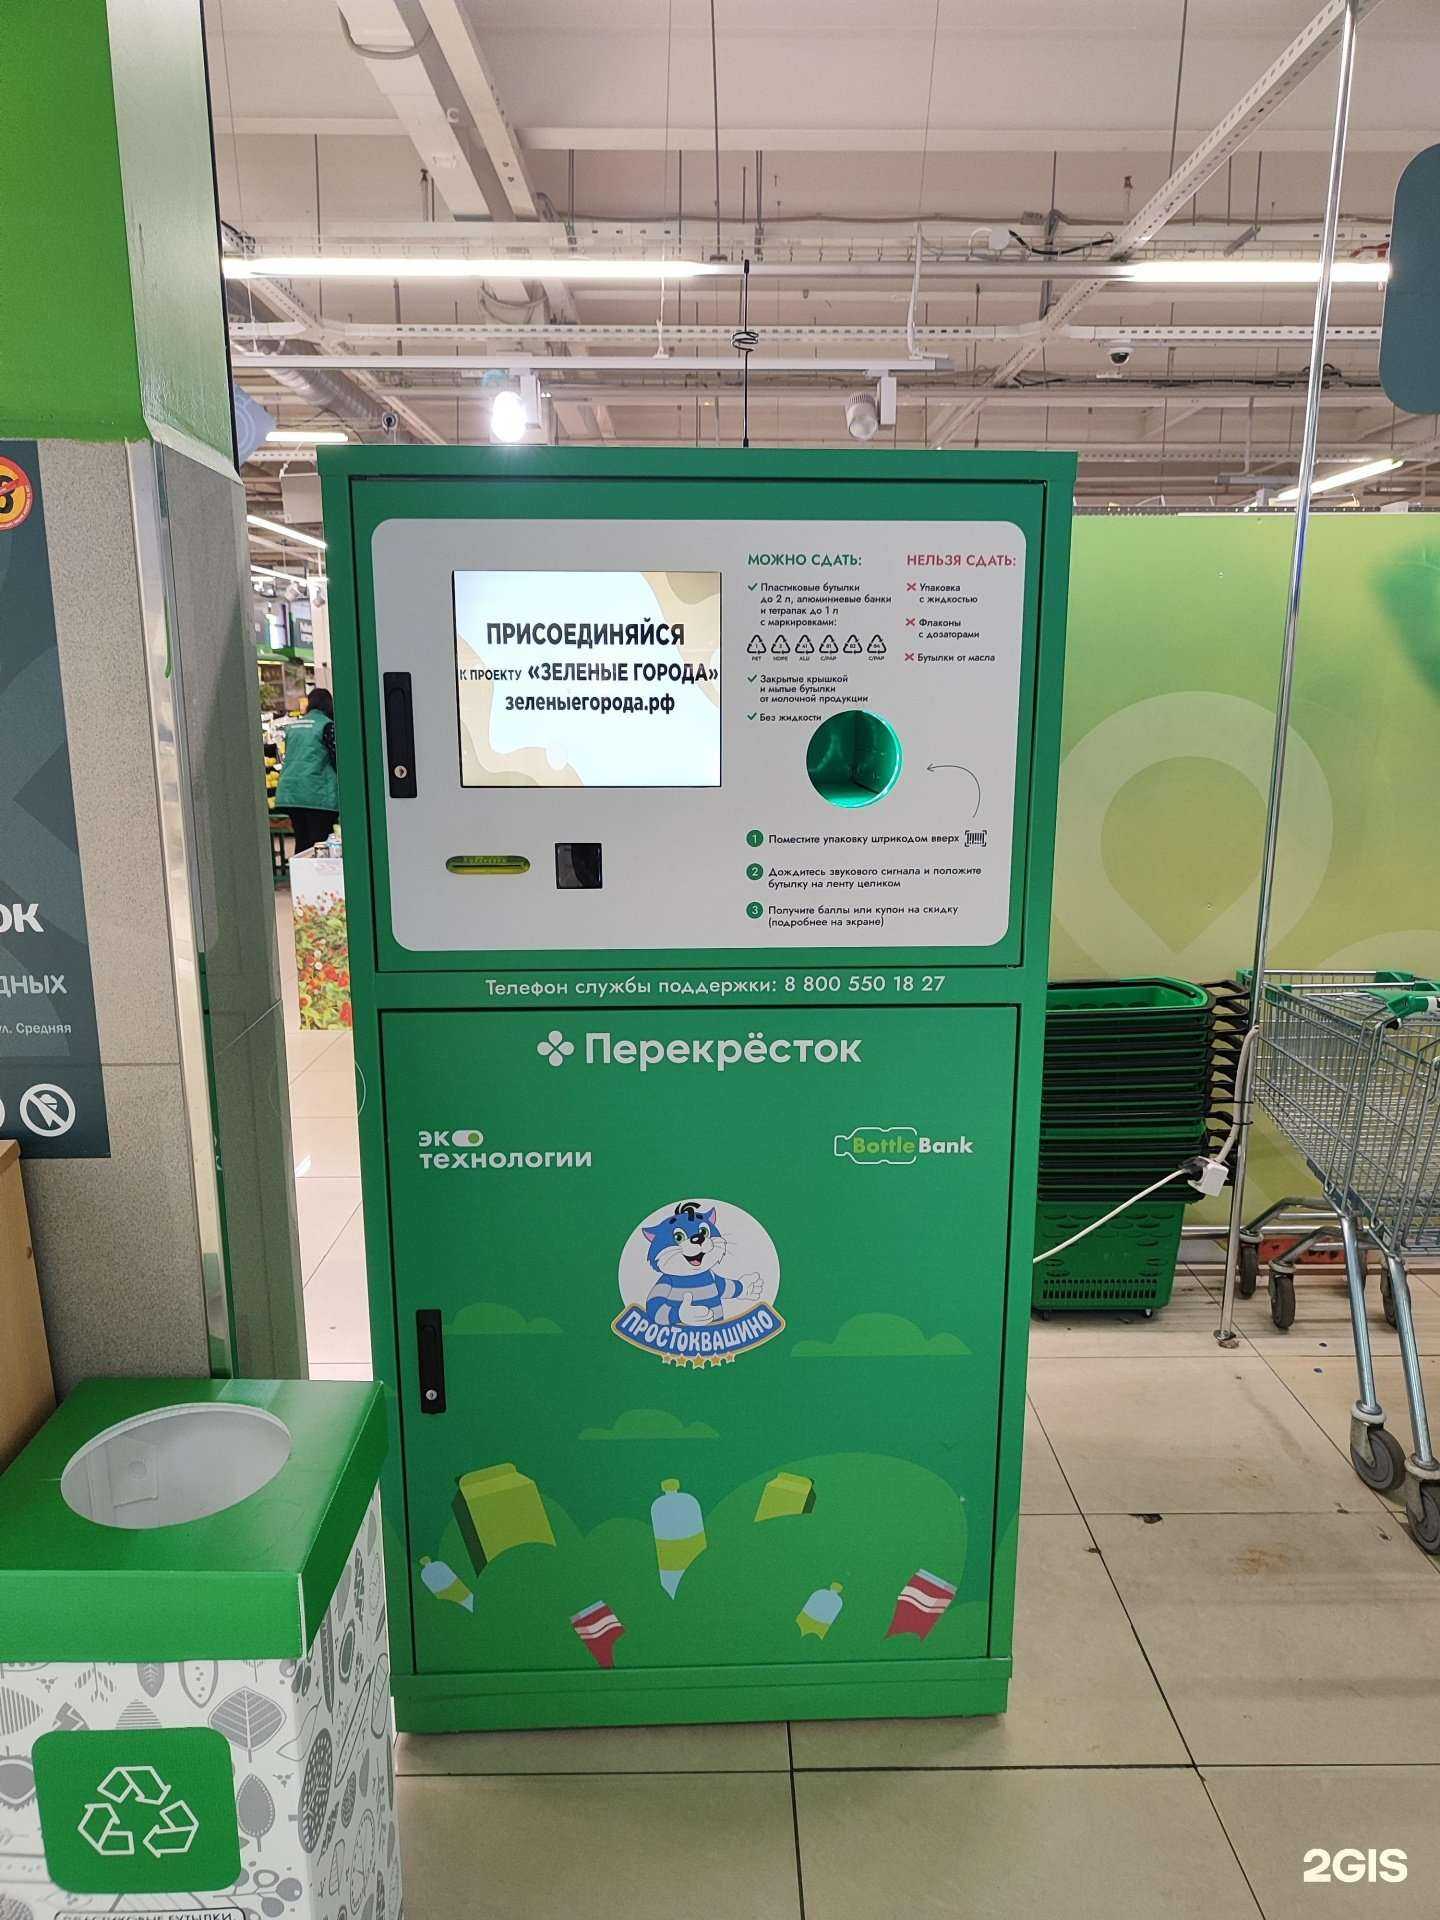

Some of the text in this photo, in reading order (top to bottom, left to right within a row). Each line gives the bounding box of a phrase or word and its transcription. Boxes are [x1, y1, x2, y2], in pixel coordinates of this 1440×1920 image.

[748, 554, 862, 567] МОЖНО СДАТЬ:
[907, 554, 1017, 567] НЕЛЬЗЯ СДАТЬ:
[761, 582, 860, 594] Пластиковые бутылки
[919, 583, 960, 594] Упаковка
[760, 596, 773, 604] до
[776, 595, 782, 603] 2
[864, 594, 892, 603] банки
[927, 596, 978, 605] жидкостью
[769, 608, 807, 617] тетрапак
[809, 608, 823, 616] до
[825, 606, 830, 615] 1
[768, 618, 837, 629] маркировками:
[919, 619, 961, 627] Флаконы
[486, 617, 685, 649] ПРИСОЕДИНЯЙСЯ
[926, 631, 979, 640] дозаторами
[918, 653, 954, 665] Бутылки
[969, 654, 995, 662] масла
[459, 662, 719, 684] К ПРОЕКТУ «ЗЕЛЕНЫЕ ГОРОДА»
[760, 674, 848, 685] Закрытые крышкой
[768, 685, 797, 693] мытые
[800, 684, 836, 695] бутылки
[505, 692, 675, 714] зеленыегорода.рф
[771, 694, 817, 702] молочной
[820, 695, 868, 705] продукции
[760, 713, 822, 723] Без жидкости
[769, 834, 959, 845] Поместите упаковку штрикодом вверх
[768, 867, 826, 877] Дождитесь
[830, 868, 878, 878] звукового
[881, 867, 921, 875] сигнала
[933, 867, 982, 875] положите
[768, 879, 808, 890] бутылку
[826, 880, 854, 889] ленту
[857, 880, 901, 889] целиком
[769, 905, 815, 917] Получите
[818, 905, 850, 913] баллы
[875, 906, 905, 915] купон
[923, 906, 958, 915] скидку
[769, 918, 828, 928] (подробнее
[846, 917, 884, 927] экране)
[486, 976, 945, 997] Телефон службы поддержки: 8 800 550 18 27
[15, 1022, 72, 1037] Средняя
[586, 1032, 862, 1072] Перекрёсток
[620, 1310, 774, 1352] ПРОСТОКВАШИНО
